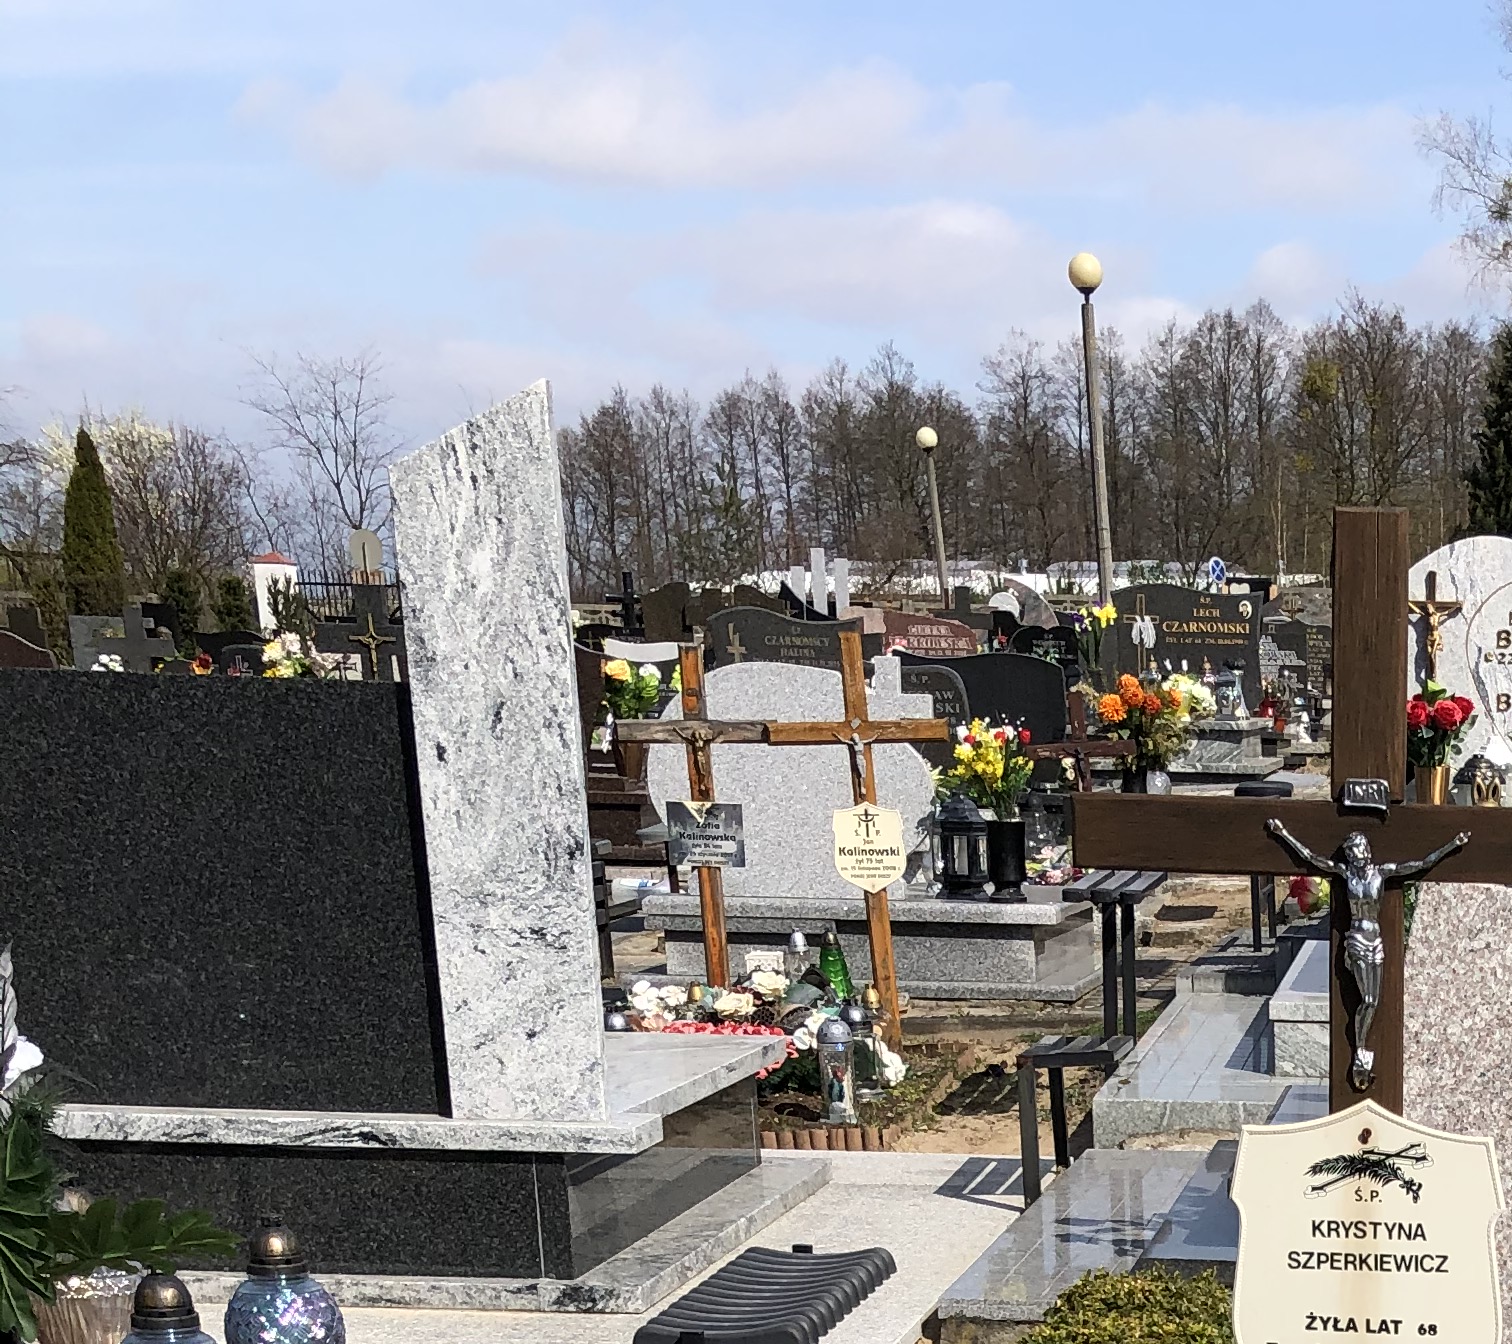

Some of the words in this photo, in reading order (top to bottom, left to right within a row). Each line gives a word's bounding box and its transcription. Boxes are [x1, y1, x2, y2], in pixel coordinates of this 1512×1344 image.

[1193, 608, 1220, 617] LECH
[1162, 621, 1250, 634] CZARNOMSKI
[679, 832, 736, 841] Kalinowska
[838, 846, 900, 856] Kalinowski
[1354, 1186, 1383, 1203] Ś.P.
[1311, 1219, 1427, 1241] KRYSTYNA
[1287, 1251, 1449, 1273] SZPERKIEWICZ
[1305, 1312, 1358, 1333] ŻYŁA
[1365, 1319, 1402, 1335] LAT
[1417, 1324, 1438, 1336] 68
